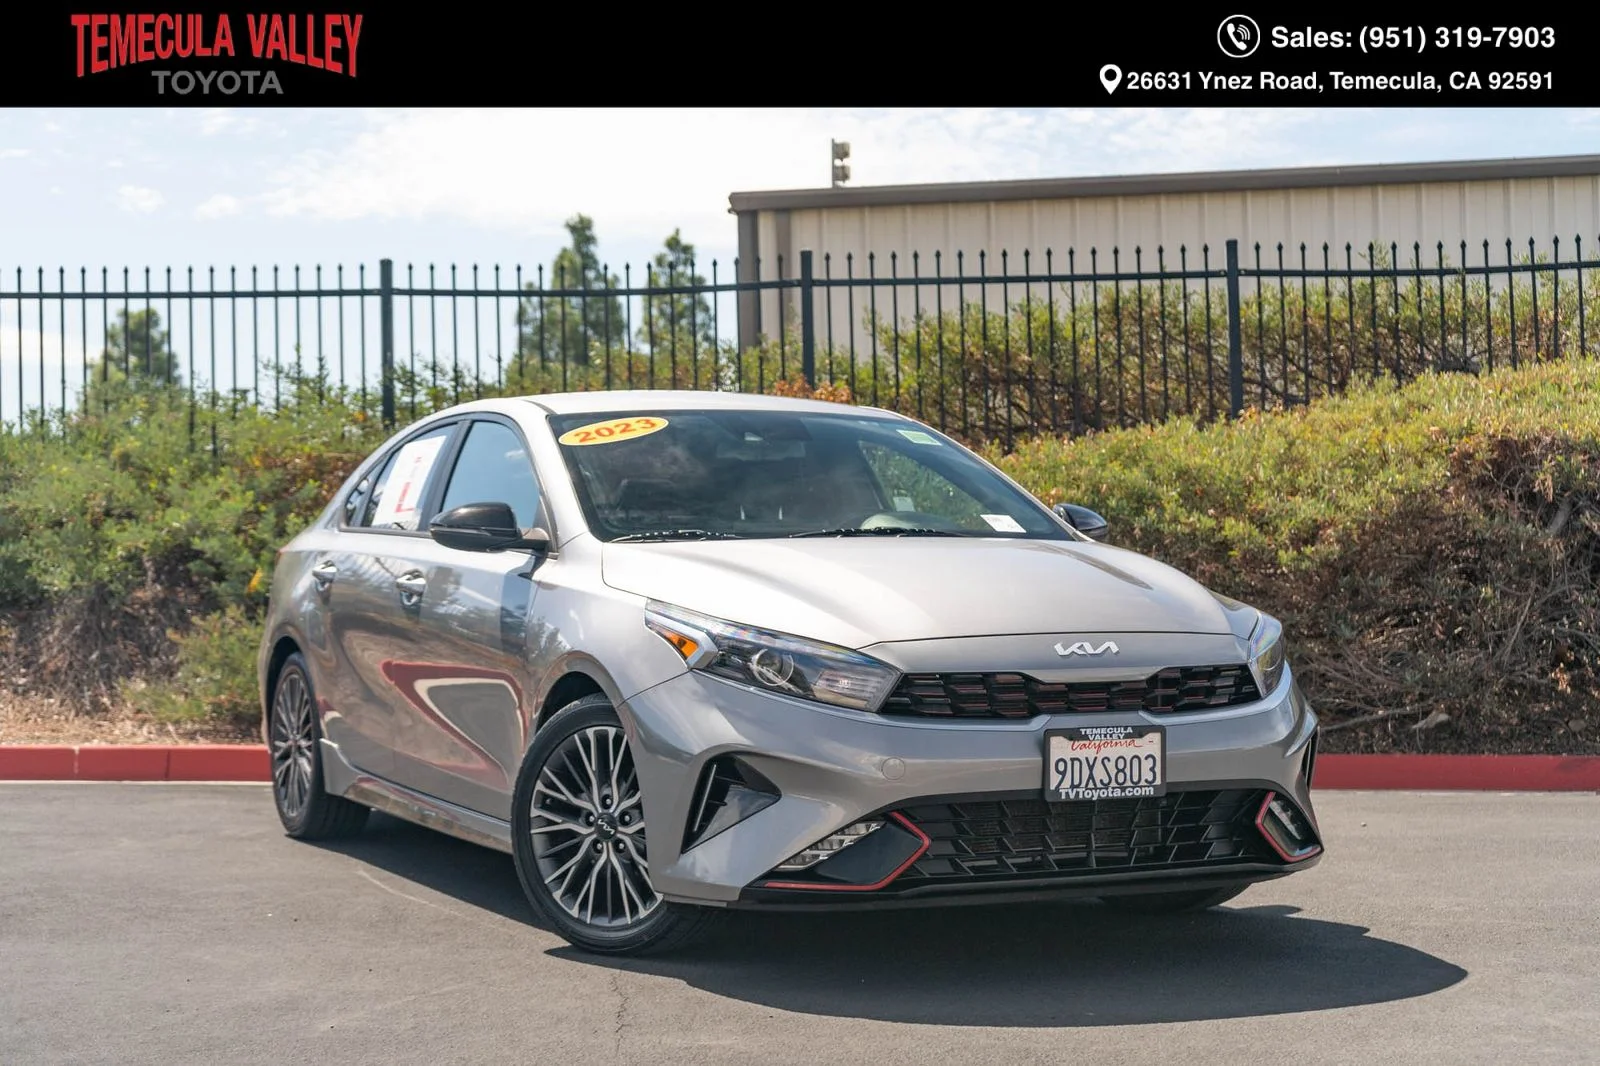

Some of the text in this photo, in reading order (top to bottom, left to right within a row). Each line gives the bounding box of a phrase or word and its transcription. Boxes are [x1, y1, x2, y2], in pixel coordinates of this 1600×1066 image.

[574, 419, 657, 443] 2023
[1054, 641, 1119, 656] KIA
[1080, 727, 1133, 735] TEMECULA
[1071, 738, 1143, 754] California
[1055, 754, 1157, 790] 9DXS803
[1060, 786, 1154, 800] TVToyota.com
